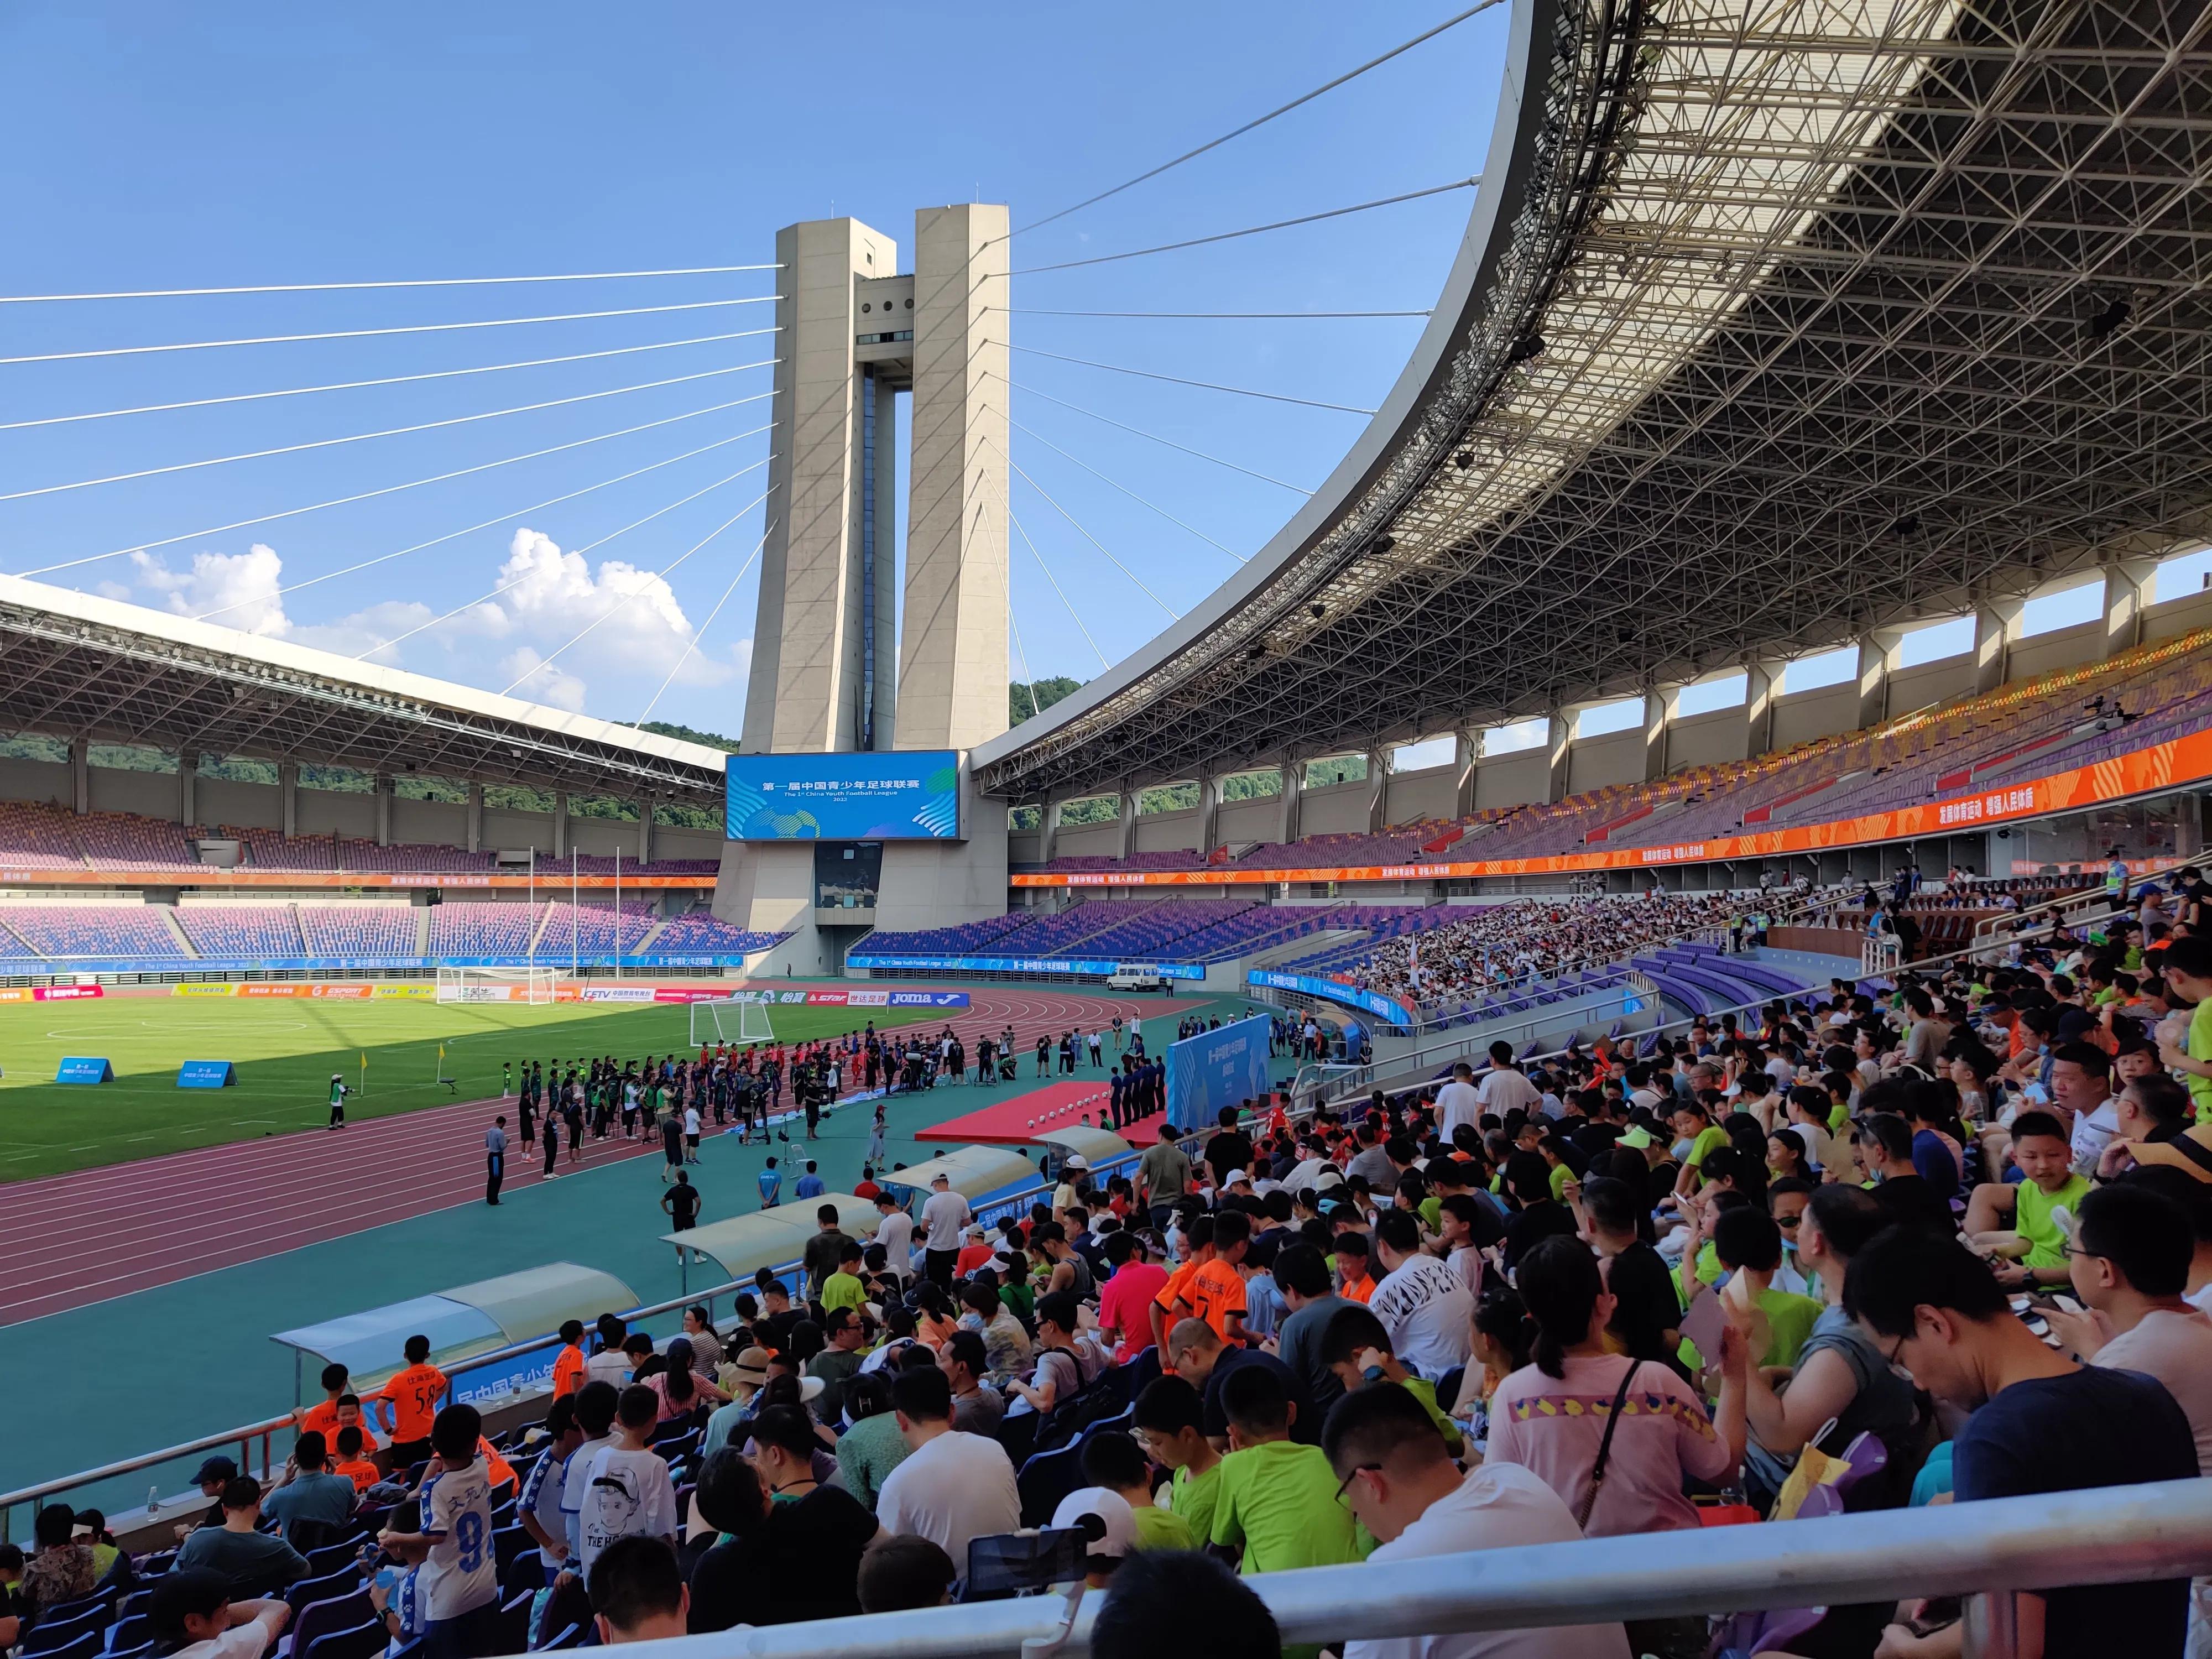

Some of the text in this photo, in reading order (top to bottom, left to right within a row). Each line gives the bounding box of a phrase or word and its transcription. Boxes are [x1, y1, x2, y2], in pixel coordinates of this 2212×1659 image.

[762, 780, 920, 791] 第一届中国青少年足球联赛
[1939, 786, 2033, 825] 发展体育运动 增强人民体质
[340, 958, 423, 967] 第一届中国青少年足球联赛
[851, 995, 886, 1003] 世达足球
[415, 1384, 436, 1415] 58
[587, 1535, 603, 1548] THE
